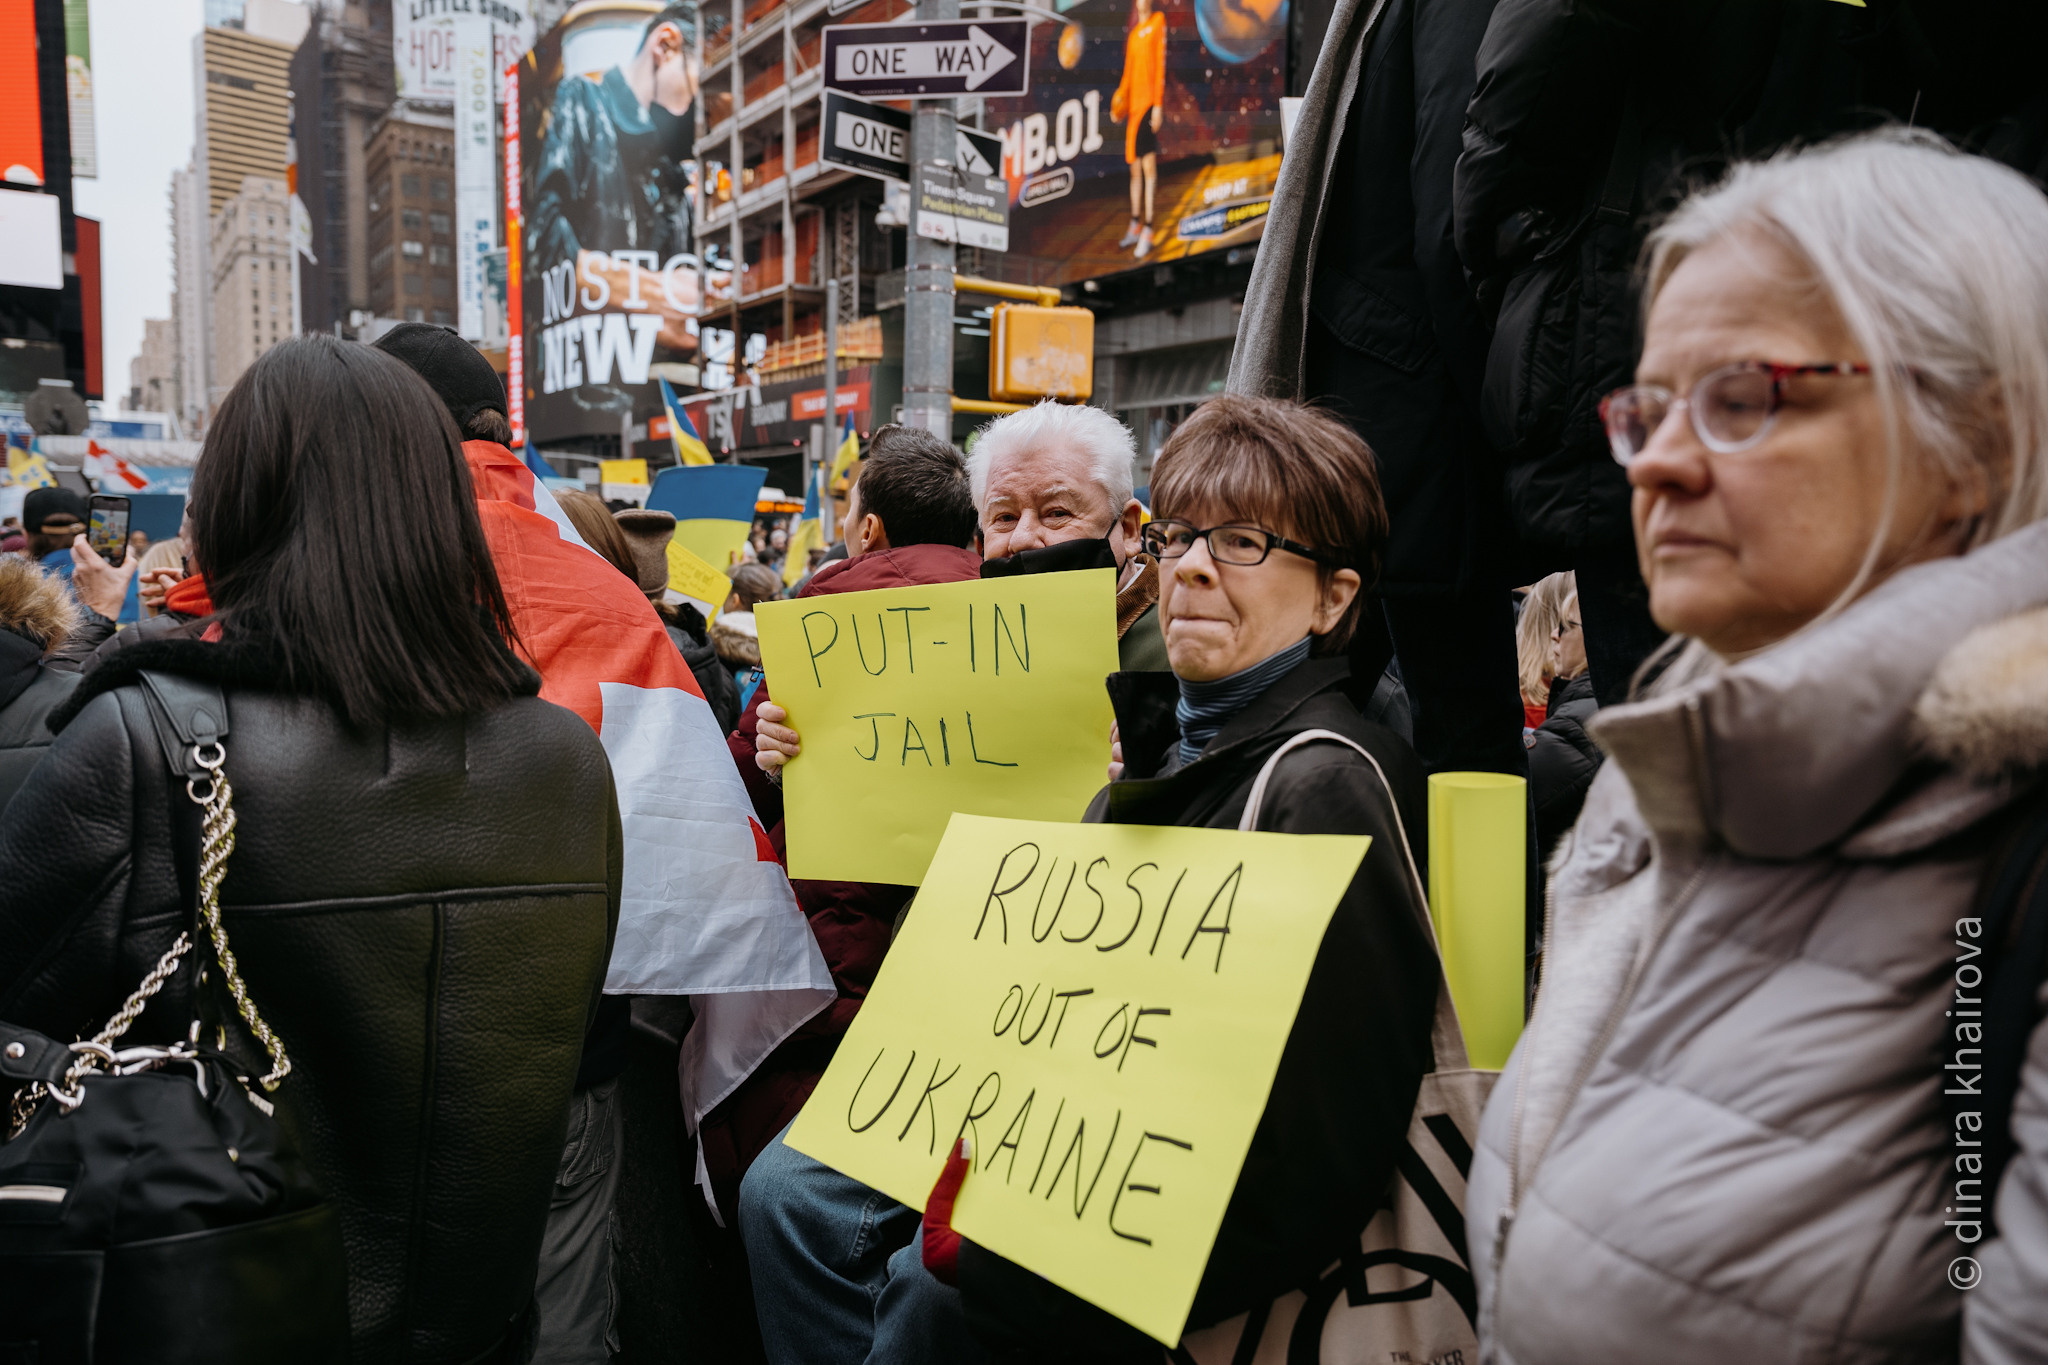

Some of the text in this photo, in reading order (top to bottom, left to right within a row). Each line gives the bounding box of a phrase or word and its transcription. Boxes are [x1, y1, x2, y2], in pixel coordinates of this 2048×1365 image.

[852, 44, 995, 75] ONE WAY
[852, 122, 904, 159] ONE
[541, 259, 577, 325] NO
[542, 313, 664, 394] NEW
[801, 602, 1031, 688] PUT-IN
[852, 711, 1019, 767] JAIL
[974, 842, 1243, 974] RUSSIA
[993, 982, 1171, 1073] OUT OF
[847, 1047, 1193, 1247] UKRAINE
